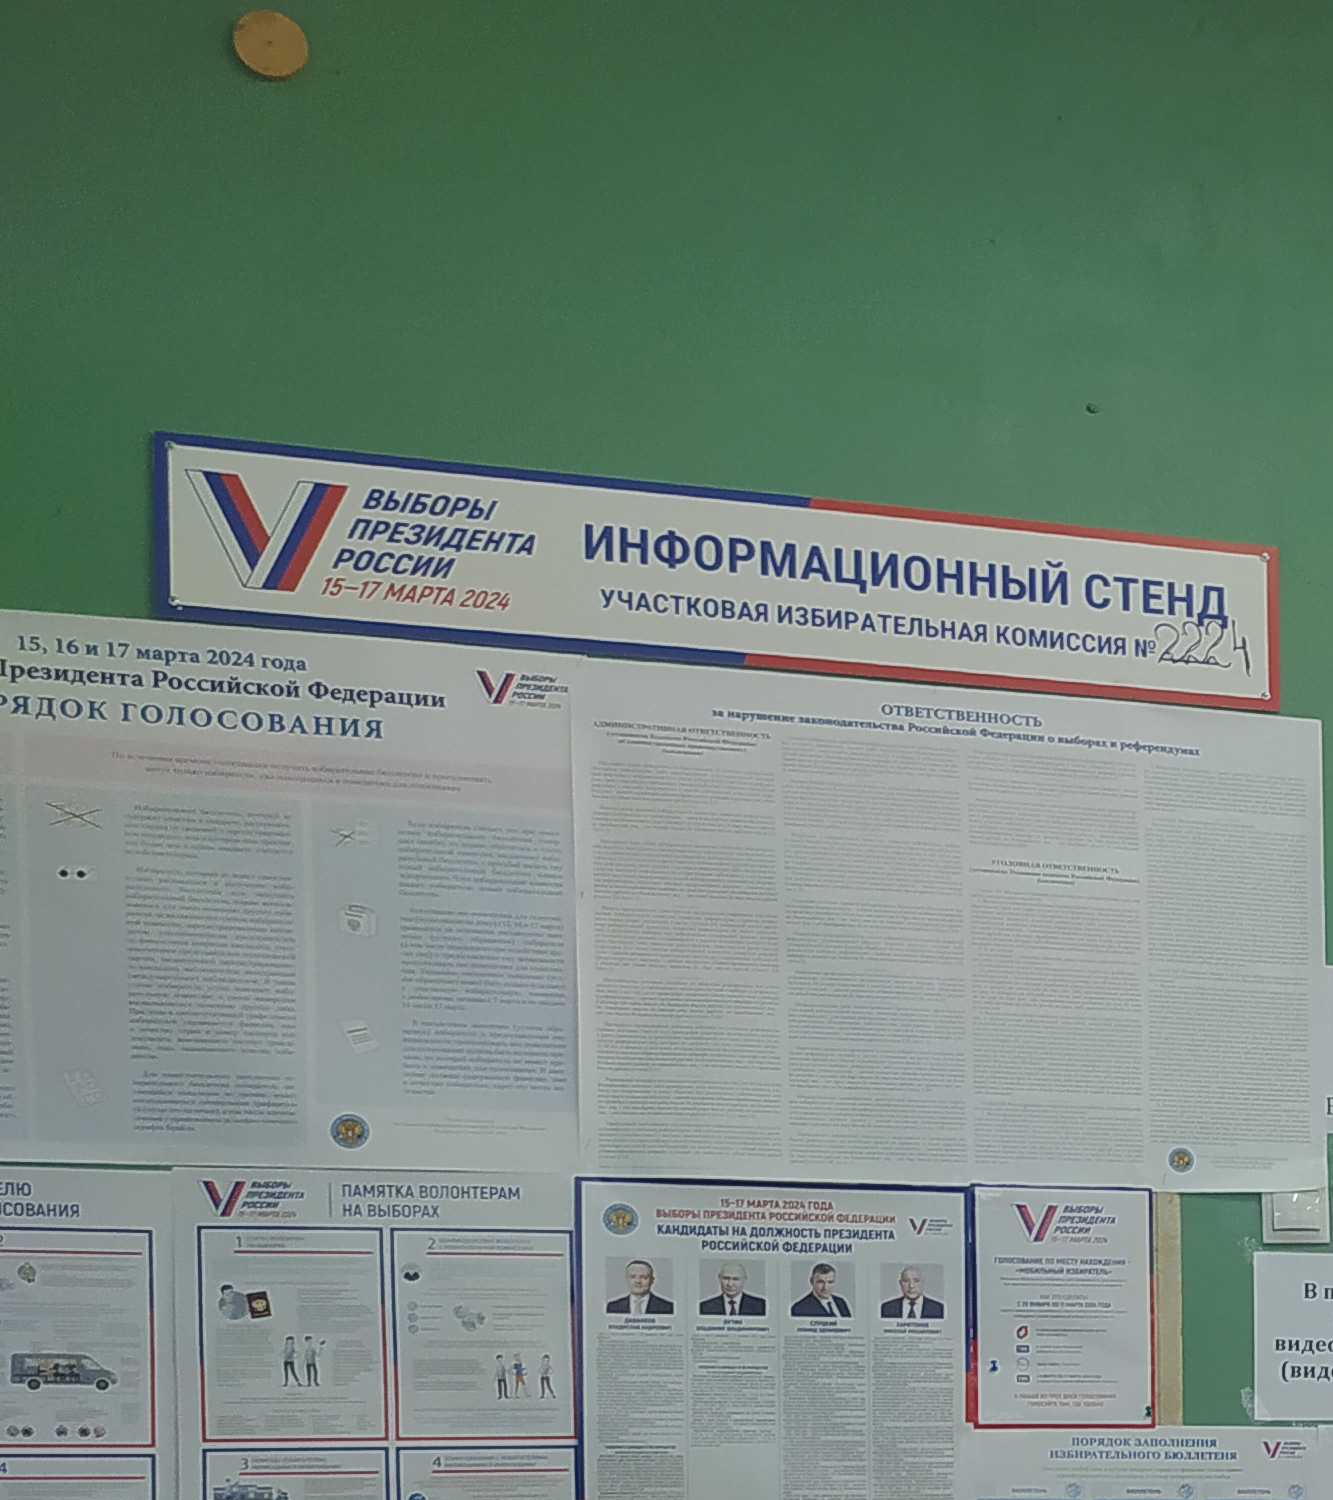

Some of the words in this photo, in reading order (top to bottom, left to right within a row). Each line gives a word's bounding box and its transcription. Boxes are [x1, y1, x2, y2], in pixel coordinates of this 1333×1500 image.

[362, 488, 498, 521] ВЫБОРЫ
[347, 518, 537, 558] ПРЕЗИДЕНТА
[331, 548, 457, 580] РОССИИ
[583, 522, 1069, 607] ИНФОРМАЦИОННЫЙ
[1085, 573, 1229, 629] СТЕНД
[383, 582, 456, 609] МАРТА
[459, 588, 511, 612] 2024
[601, 588, 769, 624] УЧАСТКОВАЯ
[776, 604, 988, 643] ИЗБИРАТЕЛЬНАЯ
[996, 623, 1128, 657] КОМИССИЯ
[18, 635, 48, 655] 15,
[55, 637, 80, 656] 16
[85, 644, 99, 657] и
[106, 642, 131, 659] 17
[136, 647, 201, 668] марта
[206, 649, 256, 669] 2024
[261, 656, 308, 672] года
[152, 669, 301, 699] Российской
[308, 681, 447, 710] Федерации
[121, 702, 385, 740] ГОЛОСОВАНИЯ
[880, 703, 1043, 729] ОТВЕТСТВЕННОСТЬ
[727, 709, 796, 724] нарушение
[798, 715, 905, 732] законодательства
[907, 721, 977, 738] Российской
[980, 727, 1045, 745] Федерации
[1047, 734, 1056, 744] о
[1057, 733, 1108, 749] выборах
[1119, 740, 1201, 757] референдумах
[341, 1183, 415, 1201] ПАМЯТКА
[418, 1185, 521, 1202] ВОЛОНТЕРАМ
[0, 1202, 80, 1218] СОВАНИЯ
[342, 1202, 365, 1218] НА
[367, 1203, 441, 1220] ВЫБОРАХ
[747, 1199, 781, 1211] МАРТА
[807, 1200, 834, 1212] ГОДА
[1062, 1205, 1104, 1215] ВЫБОРЫ
[656, 1208, 702, 1220] ВЫБОРЫ
[703, 1210, 767, 1223] ПРЕЗИДЕНТА
[768, 1210, 835, 1224] РОССИЙСКОЙ
[836, 1212, 897, 1226] ФЕДЕРАЦИИ
[1057, 1215, 1116, 1226] ПРЕЗИДЕНТА
[656, 1223, 730, 1238] КАНДИДАТЫ
[732, 1225, 748, 1238] НА
[749, 1226, 821, 1241] ДОЛЖНОСТЬ
[823, 1228, 896, 1242] ПРЕЗИДЕНТА
[1053, 1225, 1091, 1235] РОССИИ
[701, 1237, 780, 1253] РОССИЙСКОЙ
[782, 1241, 854, 1256] ФЕДЕРАЦИИ
[1303, 1282, 1318, 1300] В
[1072, 1436, 1132, 1449] ПОРЯДОК
[1134, 1437, 1217, 1449] ЗАПОЛНЕНИЯ
[432, 1456, 442, 1467] 4
[1049, 1449, 1161, 1461] ИЗБИРАТЕЛЬНОГО
[1164, 1450, 1238, 1462] БЮЛЛЕТЕНЯ
